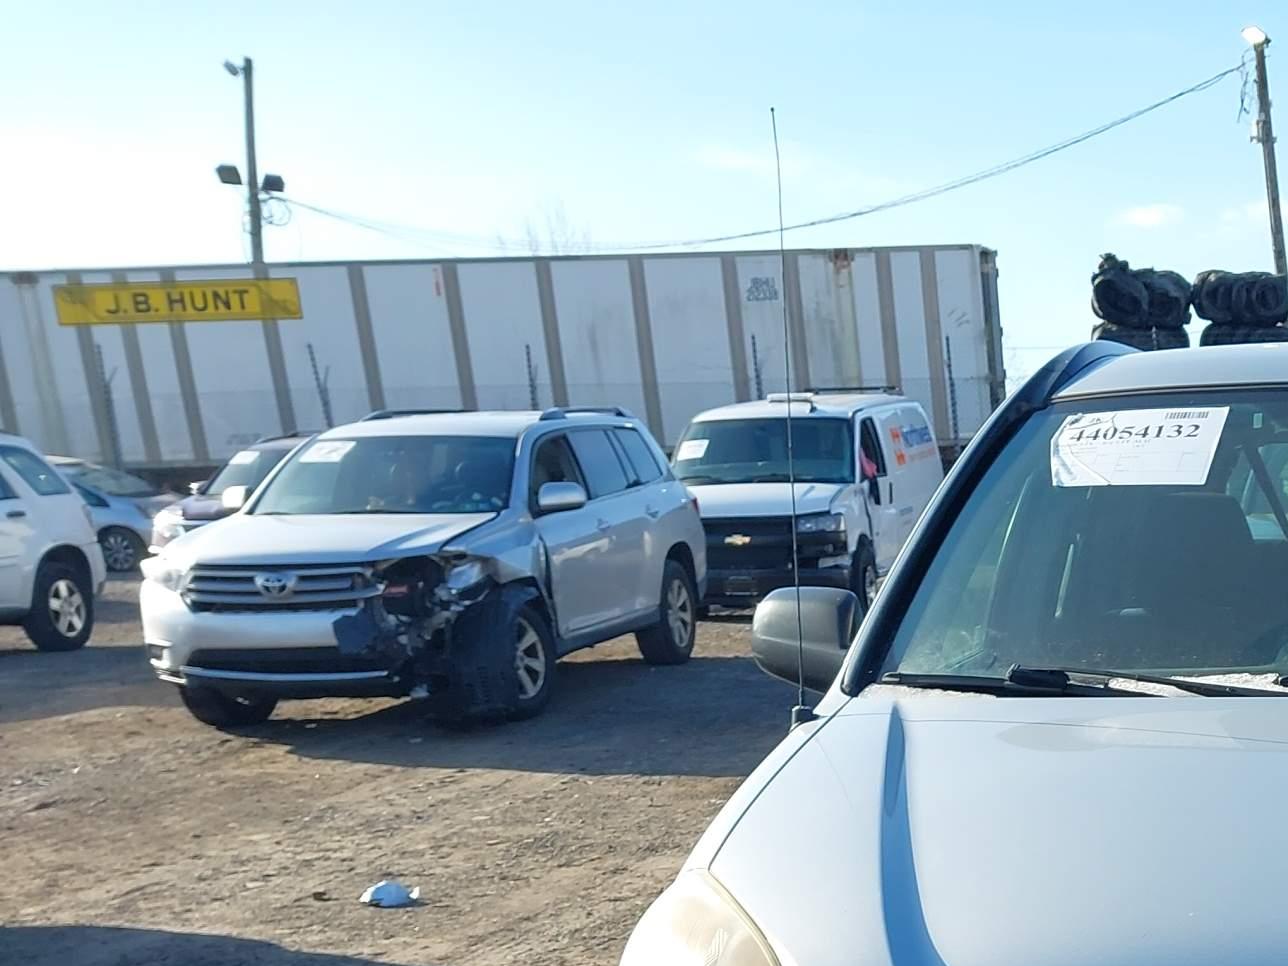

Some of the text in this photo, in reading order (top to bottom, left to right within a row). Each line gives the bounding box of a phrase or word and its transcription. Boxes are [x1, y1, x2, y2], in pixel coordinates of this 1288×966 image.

[105, 289, 249, 314] J.B. HUNT
[1069, 424, 1201, 442] 44054132
